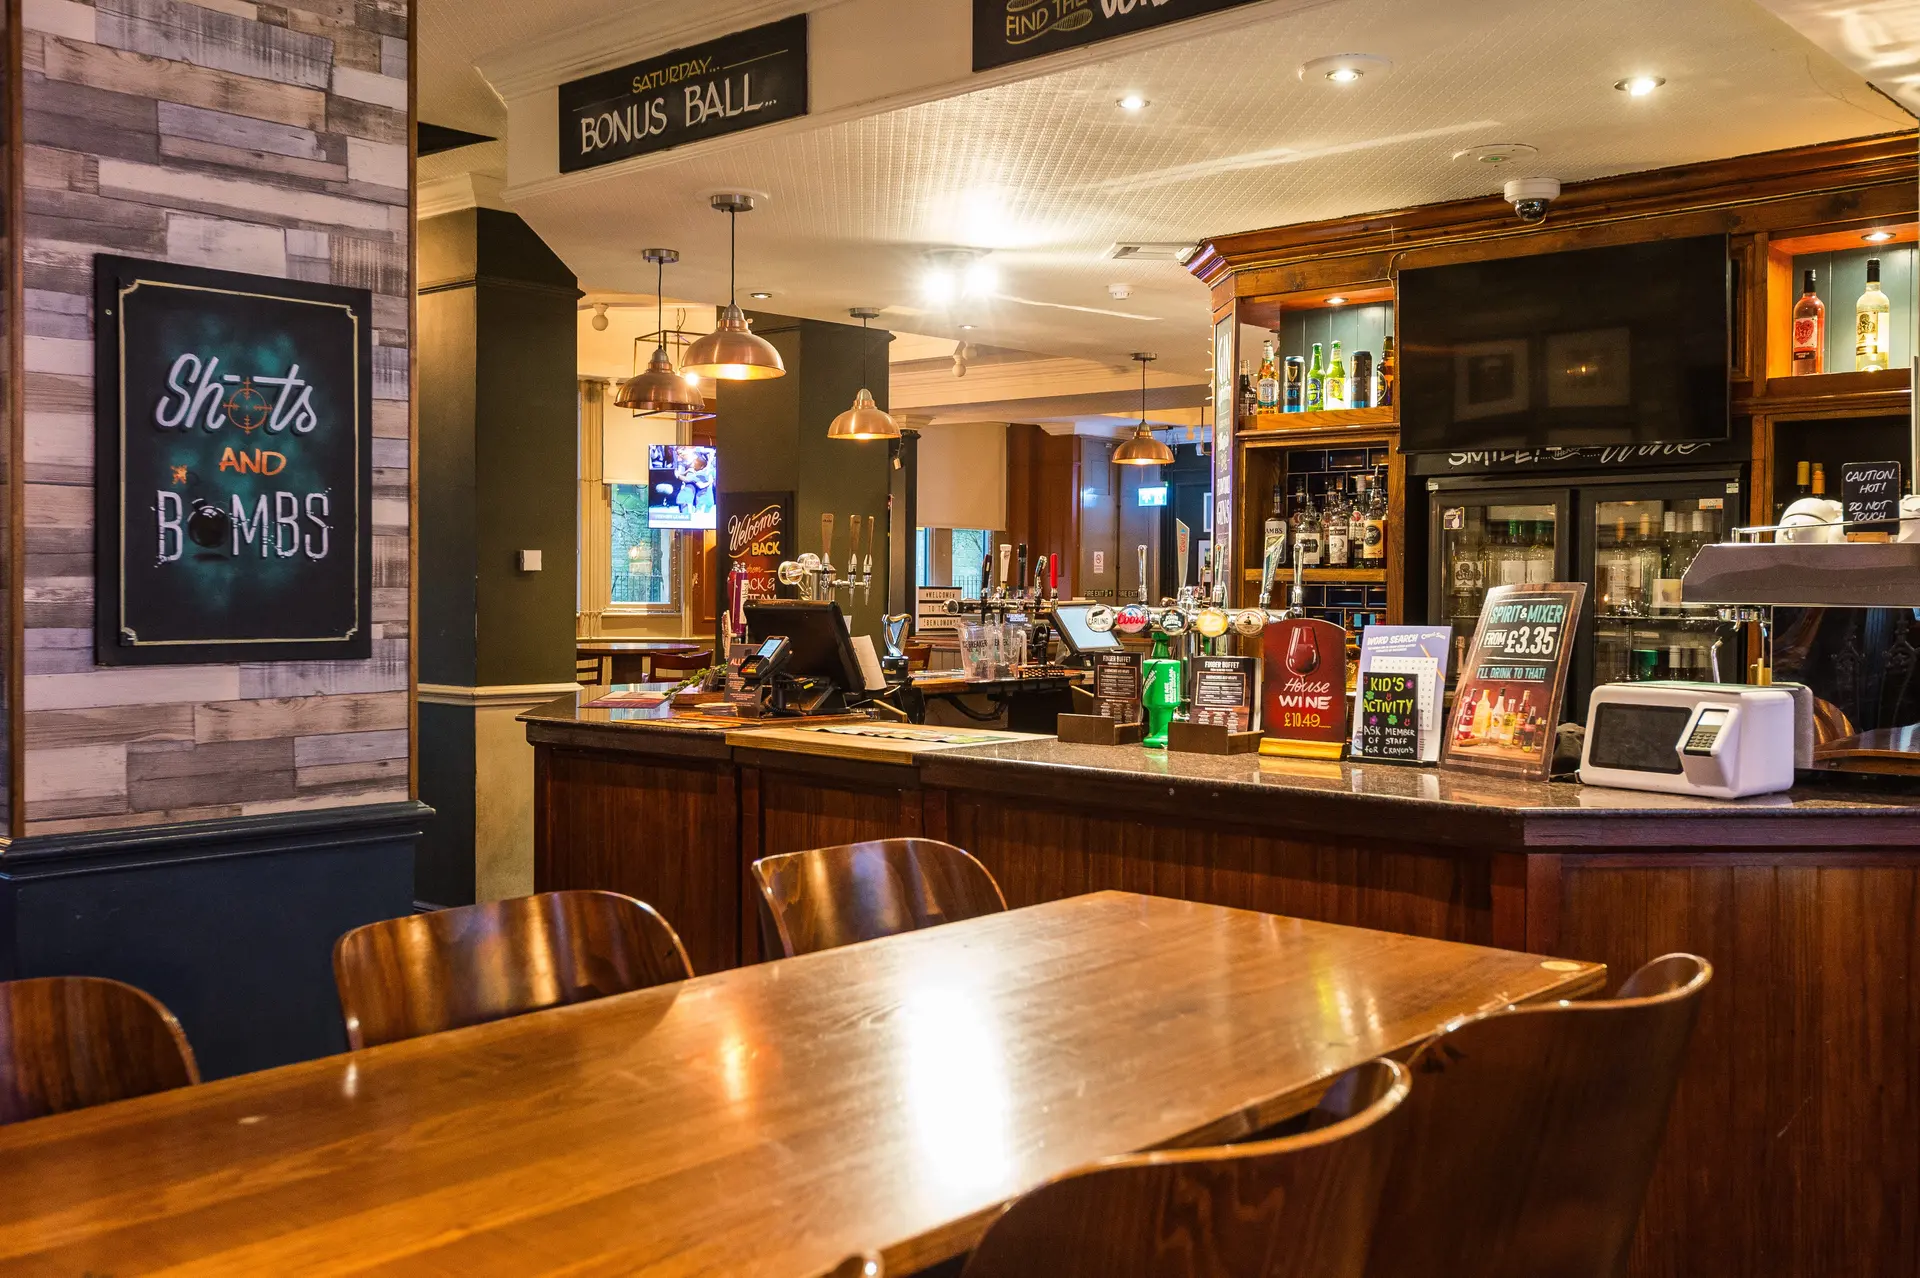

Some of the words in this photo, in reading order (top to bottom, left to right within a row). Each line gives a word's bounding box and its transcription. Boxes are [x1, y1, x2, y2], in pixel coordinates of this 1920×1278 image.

[1006, 8, 1049, 37] FIND
[581, 97, 668, 155] BONUS
[218, 446, 287, 476] AND
[1845, 469, 1896, 482] CAUTION
[1859, 482, 1887, 495] HOT!
[1849, 501, 1863, 511] DO
[1865, 500, 1893, 510] NOT
[1852, 511, 1887, 521] TOUCH
[728, 511, 782, 551] Welcome
[752, 541, 781, 556] BACK
[1117, 612, 1145, 625] Coors
[1489, 605, 1523, 624] SPIRIT
[1526, 604, 1564, 623] MIXER
[1367, 636, 1389, 646] WORD
[1389, 634, 1419, 644] SEARCH
[1483, 632, 1507, 646] FROM
[1504, 626, 1558, 654] £3.35
[1489, 668, 1513, 679] DRINK
[1514, 668, 1524, 679] TO
[1524, 668, 1547, 680] THAT!
[1283, 677, 1331, 693] House
[1370, 677, 1405, 692] KID'S
[1278, 695, 1333, 710] WINE
[1363, 699, 1414, 714] ACTIVITY
[1284, 712, 1321, 728] £10.49
[1363, 725, 1381, 736] ASK
[1385, 727, 1416, 737] MEMBER
